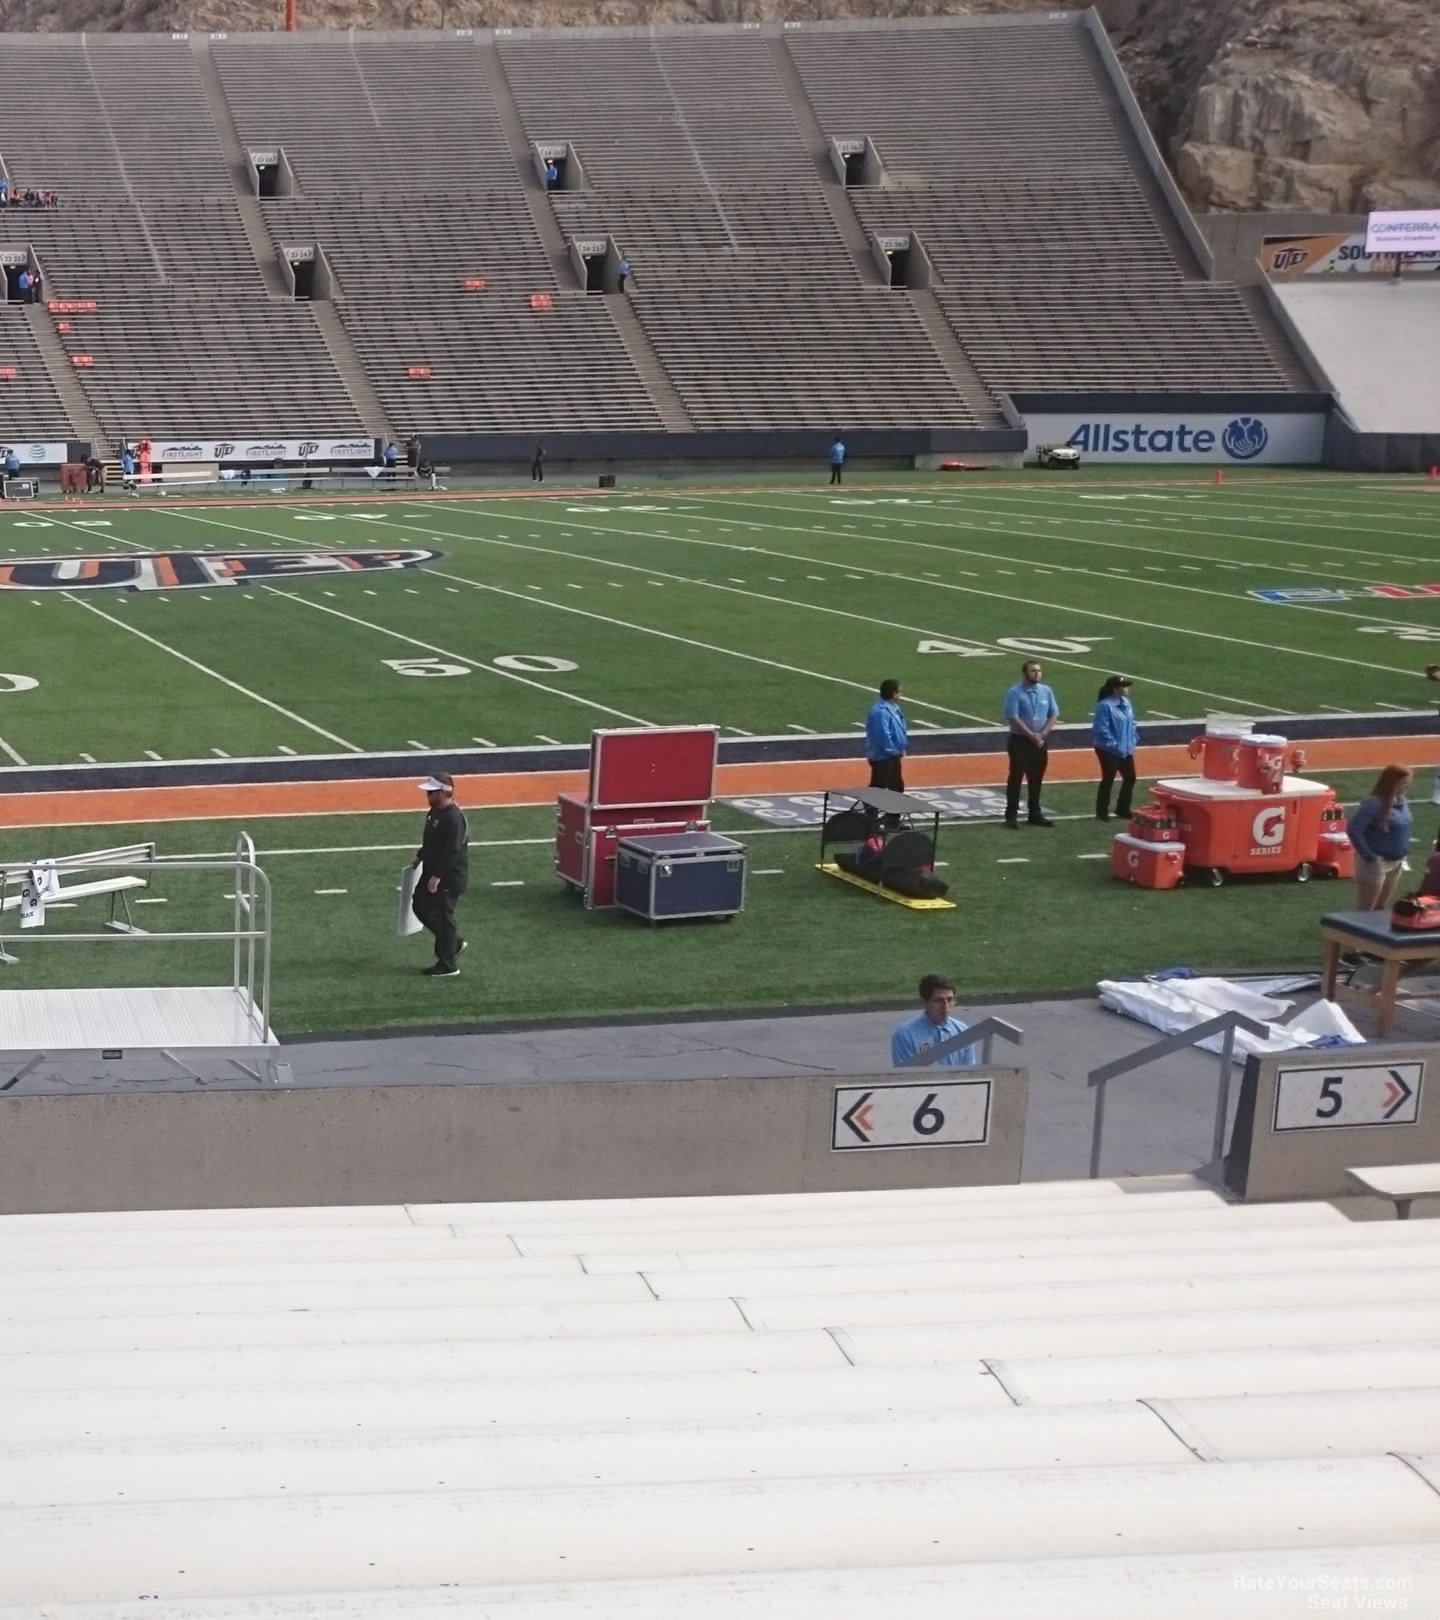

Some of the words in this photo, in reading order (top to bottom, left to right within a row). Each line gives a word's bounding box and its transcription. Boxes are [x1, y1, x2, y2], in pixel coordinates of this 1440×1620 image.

[1069, 423, 1216, 453] Allstate
[1253, 806, 1285, 846] G
[1127, 850, 1139, 867] G
[1250, 846, 1282, 856] SERIES
[913, 1093, 945, 1136] 6
[1316, 1076, 1343, 1119] 5
